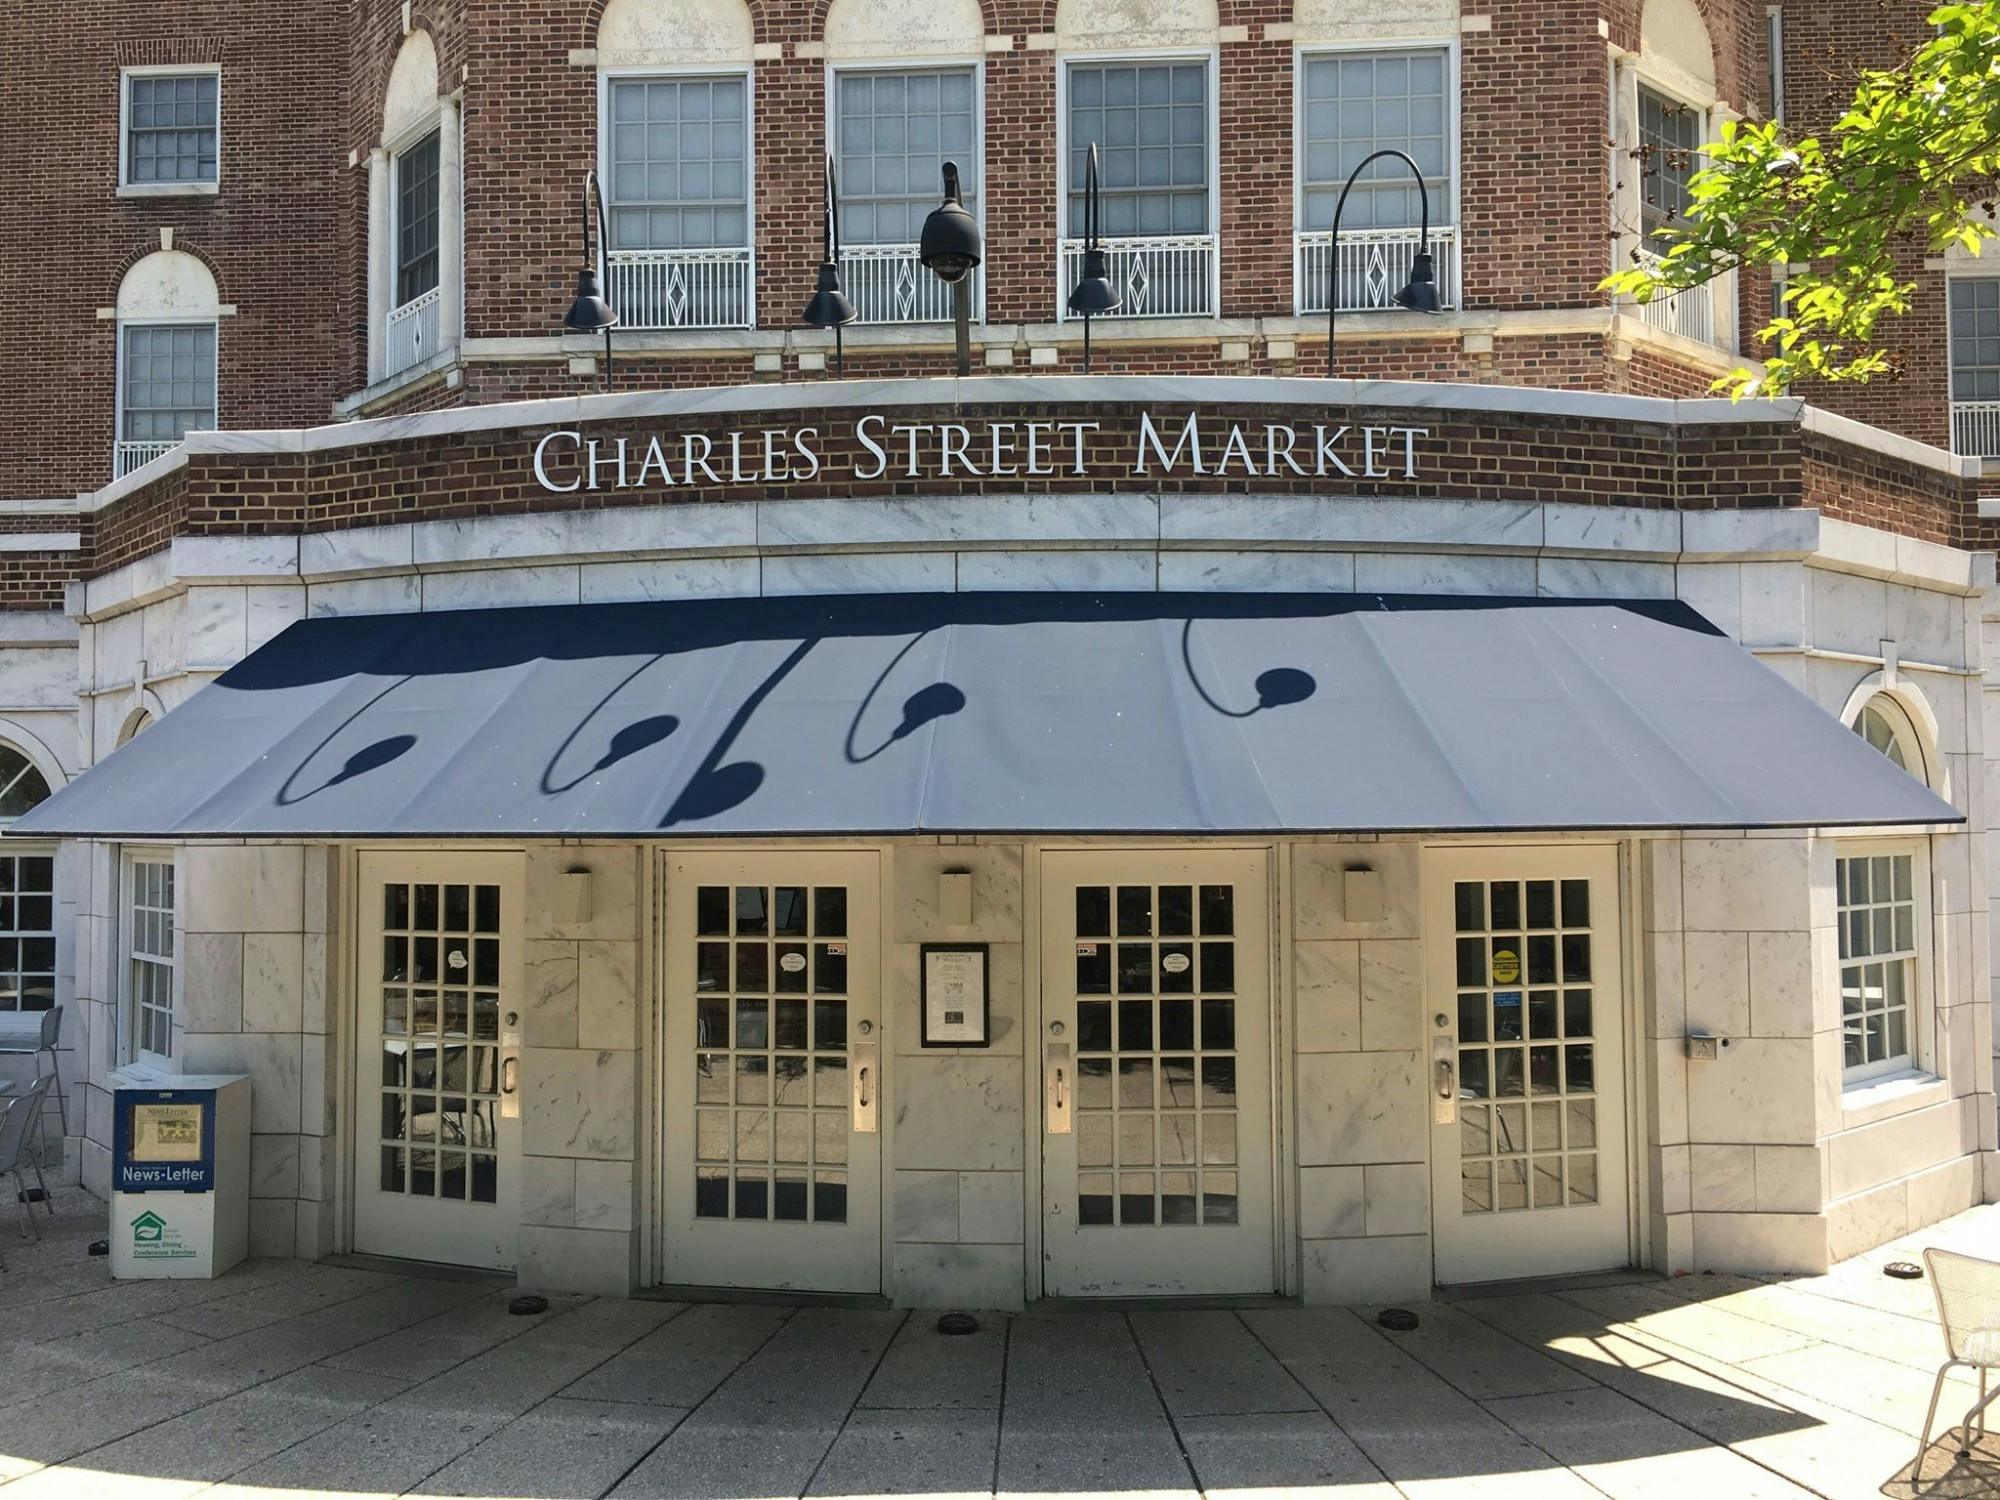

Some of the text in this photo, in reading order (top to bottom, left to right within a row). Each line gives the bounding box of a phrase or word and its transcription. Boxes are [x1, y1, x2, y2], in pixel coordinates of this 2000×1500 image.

[533, 410, 1429, 493] CHARLES STREET MARKET
[122, 1166, 205, 1182] News-Letter
